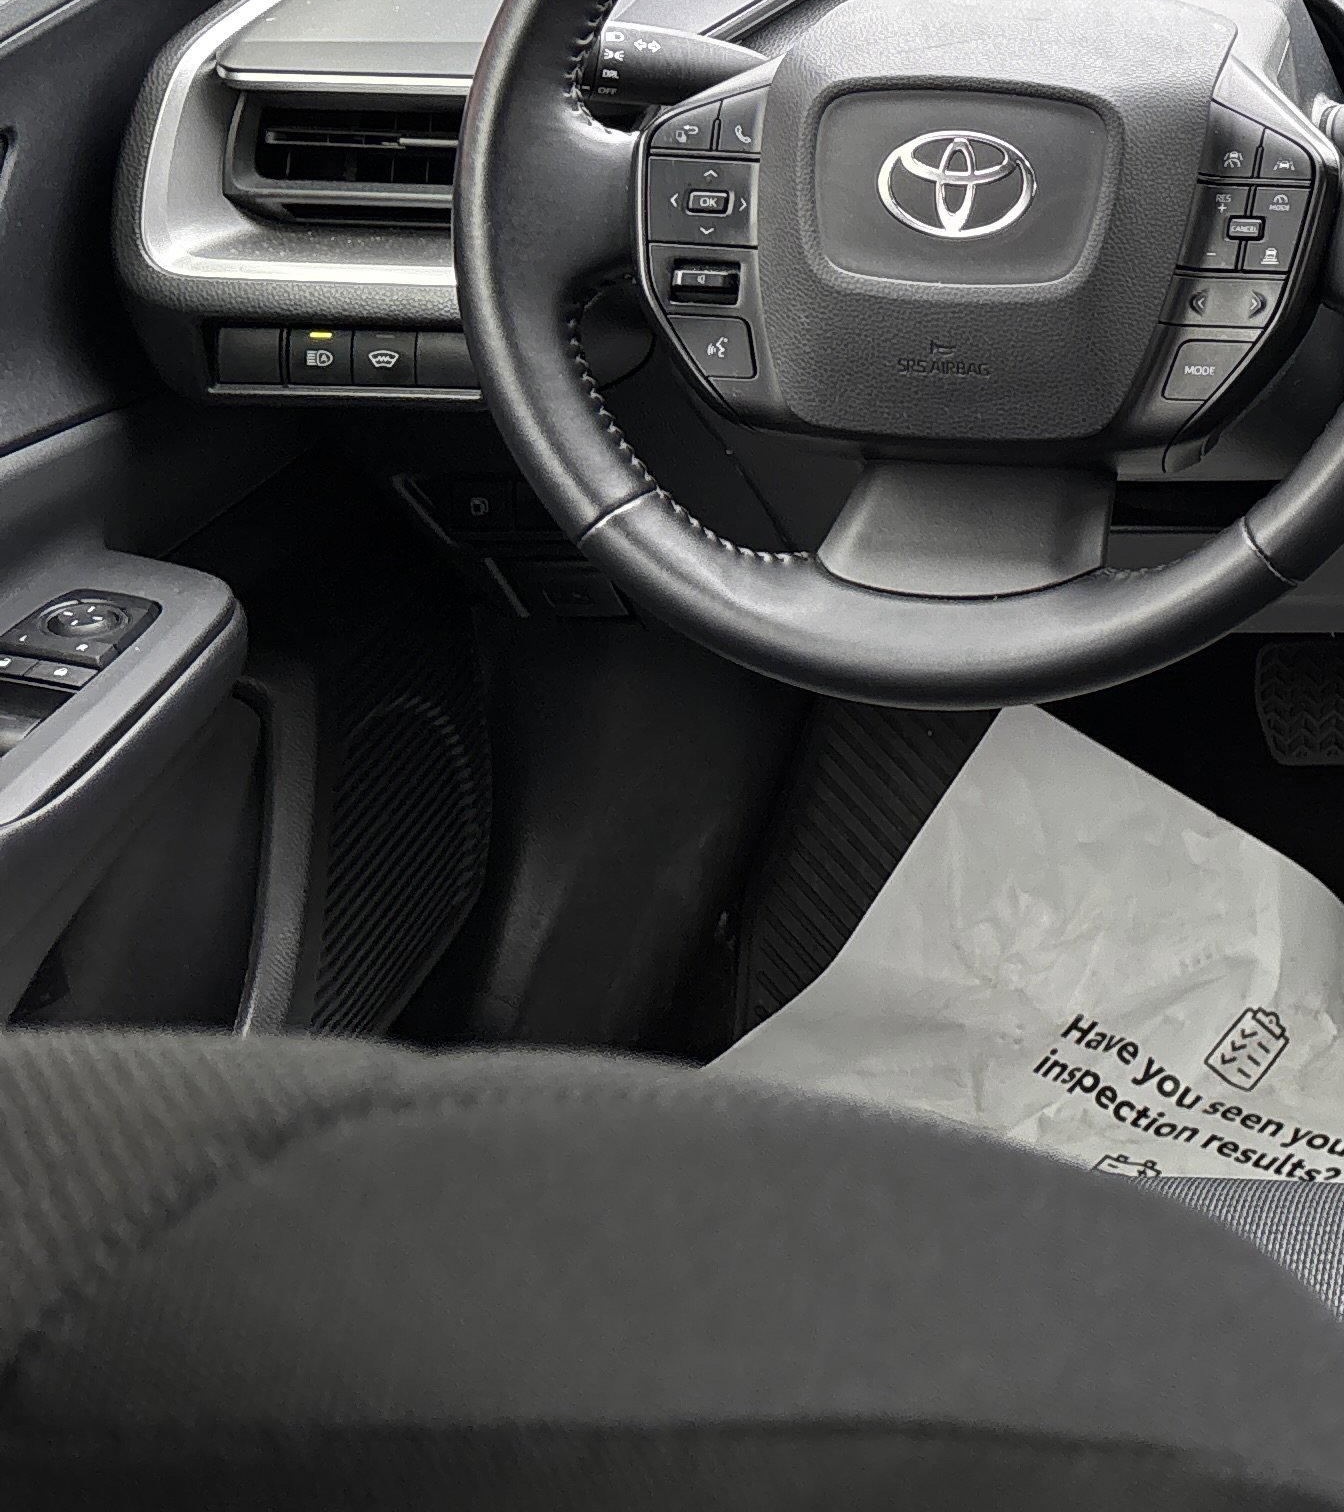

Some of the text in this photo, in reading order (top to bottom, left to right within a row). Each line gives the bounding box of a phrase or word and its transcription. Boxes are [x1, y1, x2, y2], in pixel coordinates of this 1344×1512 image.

[597, 87, 618, 95] OFF
[699, 197, 718, 208] OK
[1215, 194, 1232, 203] RES
[1230, 225, 1258, 233] CANCEL
[897, 358, 991, 378] SRS AIRBAG
[1184, 365, 1216, 376] MODE
[1060, 1013, 1140, 1065] Have
[1131, 1056, 1203, 1110] you
[1202, 1099, 1285, 1137] seen
[1032, 1048, 1200, 1144] inspection
